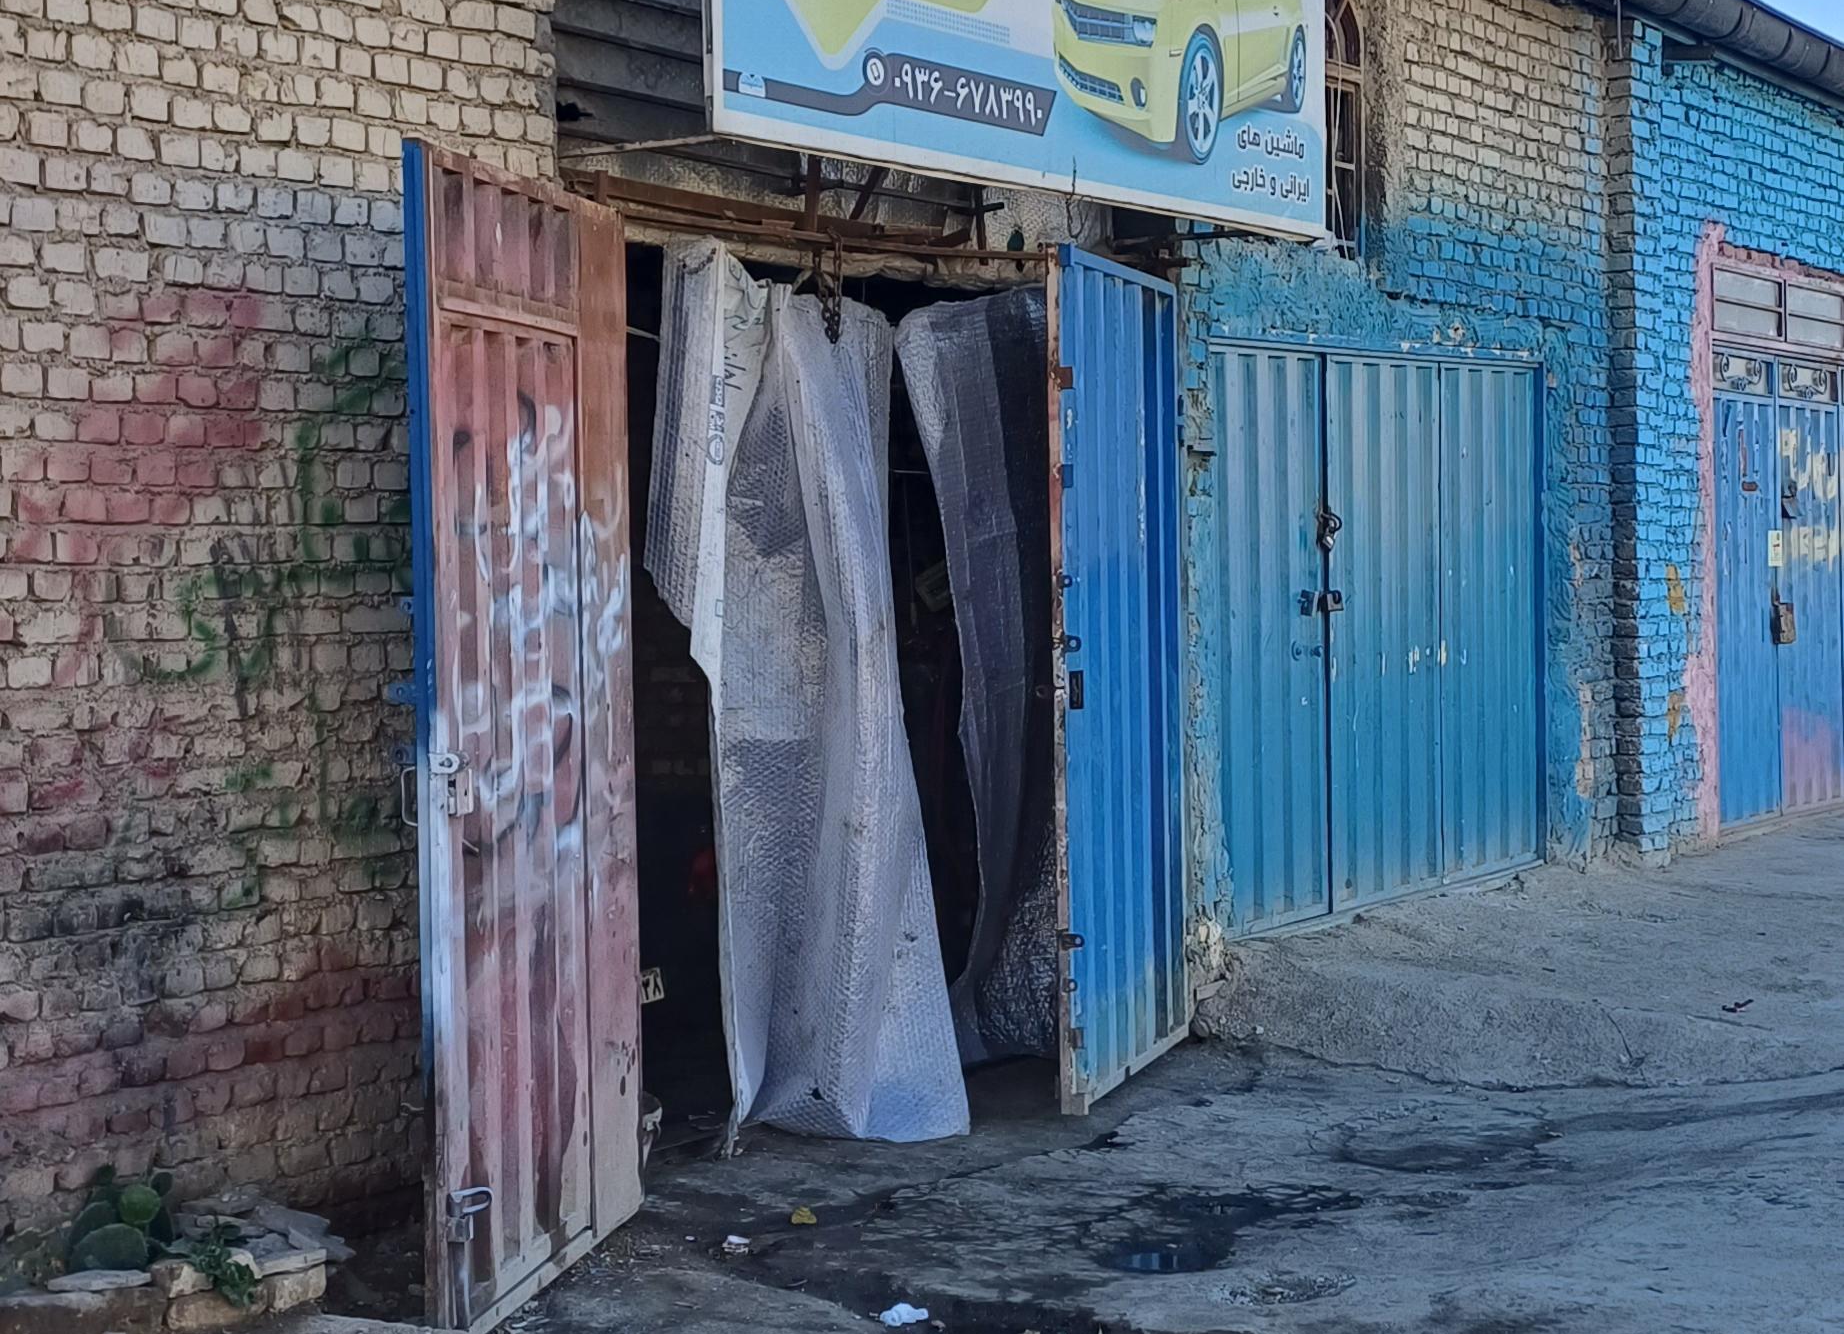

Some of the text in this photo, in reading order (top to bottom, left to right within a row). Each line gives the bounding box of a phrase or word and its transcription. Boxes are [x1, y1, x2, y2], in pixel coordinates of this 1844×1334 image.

[894, 63, 1043, 127] ۰۹۳۶-۶۷۸۳۹۹۰
[1237, 124, 1305, 160] ماشین های
[1232, 166, 1310, 203] ایرانی و خارجی
